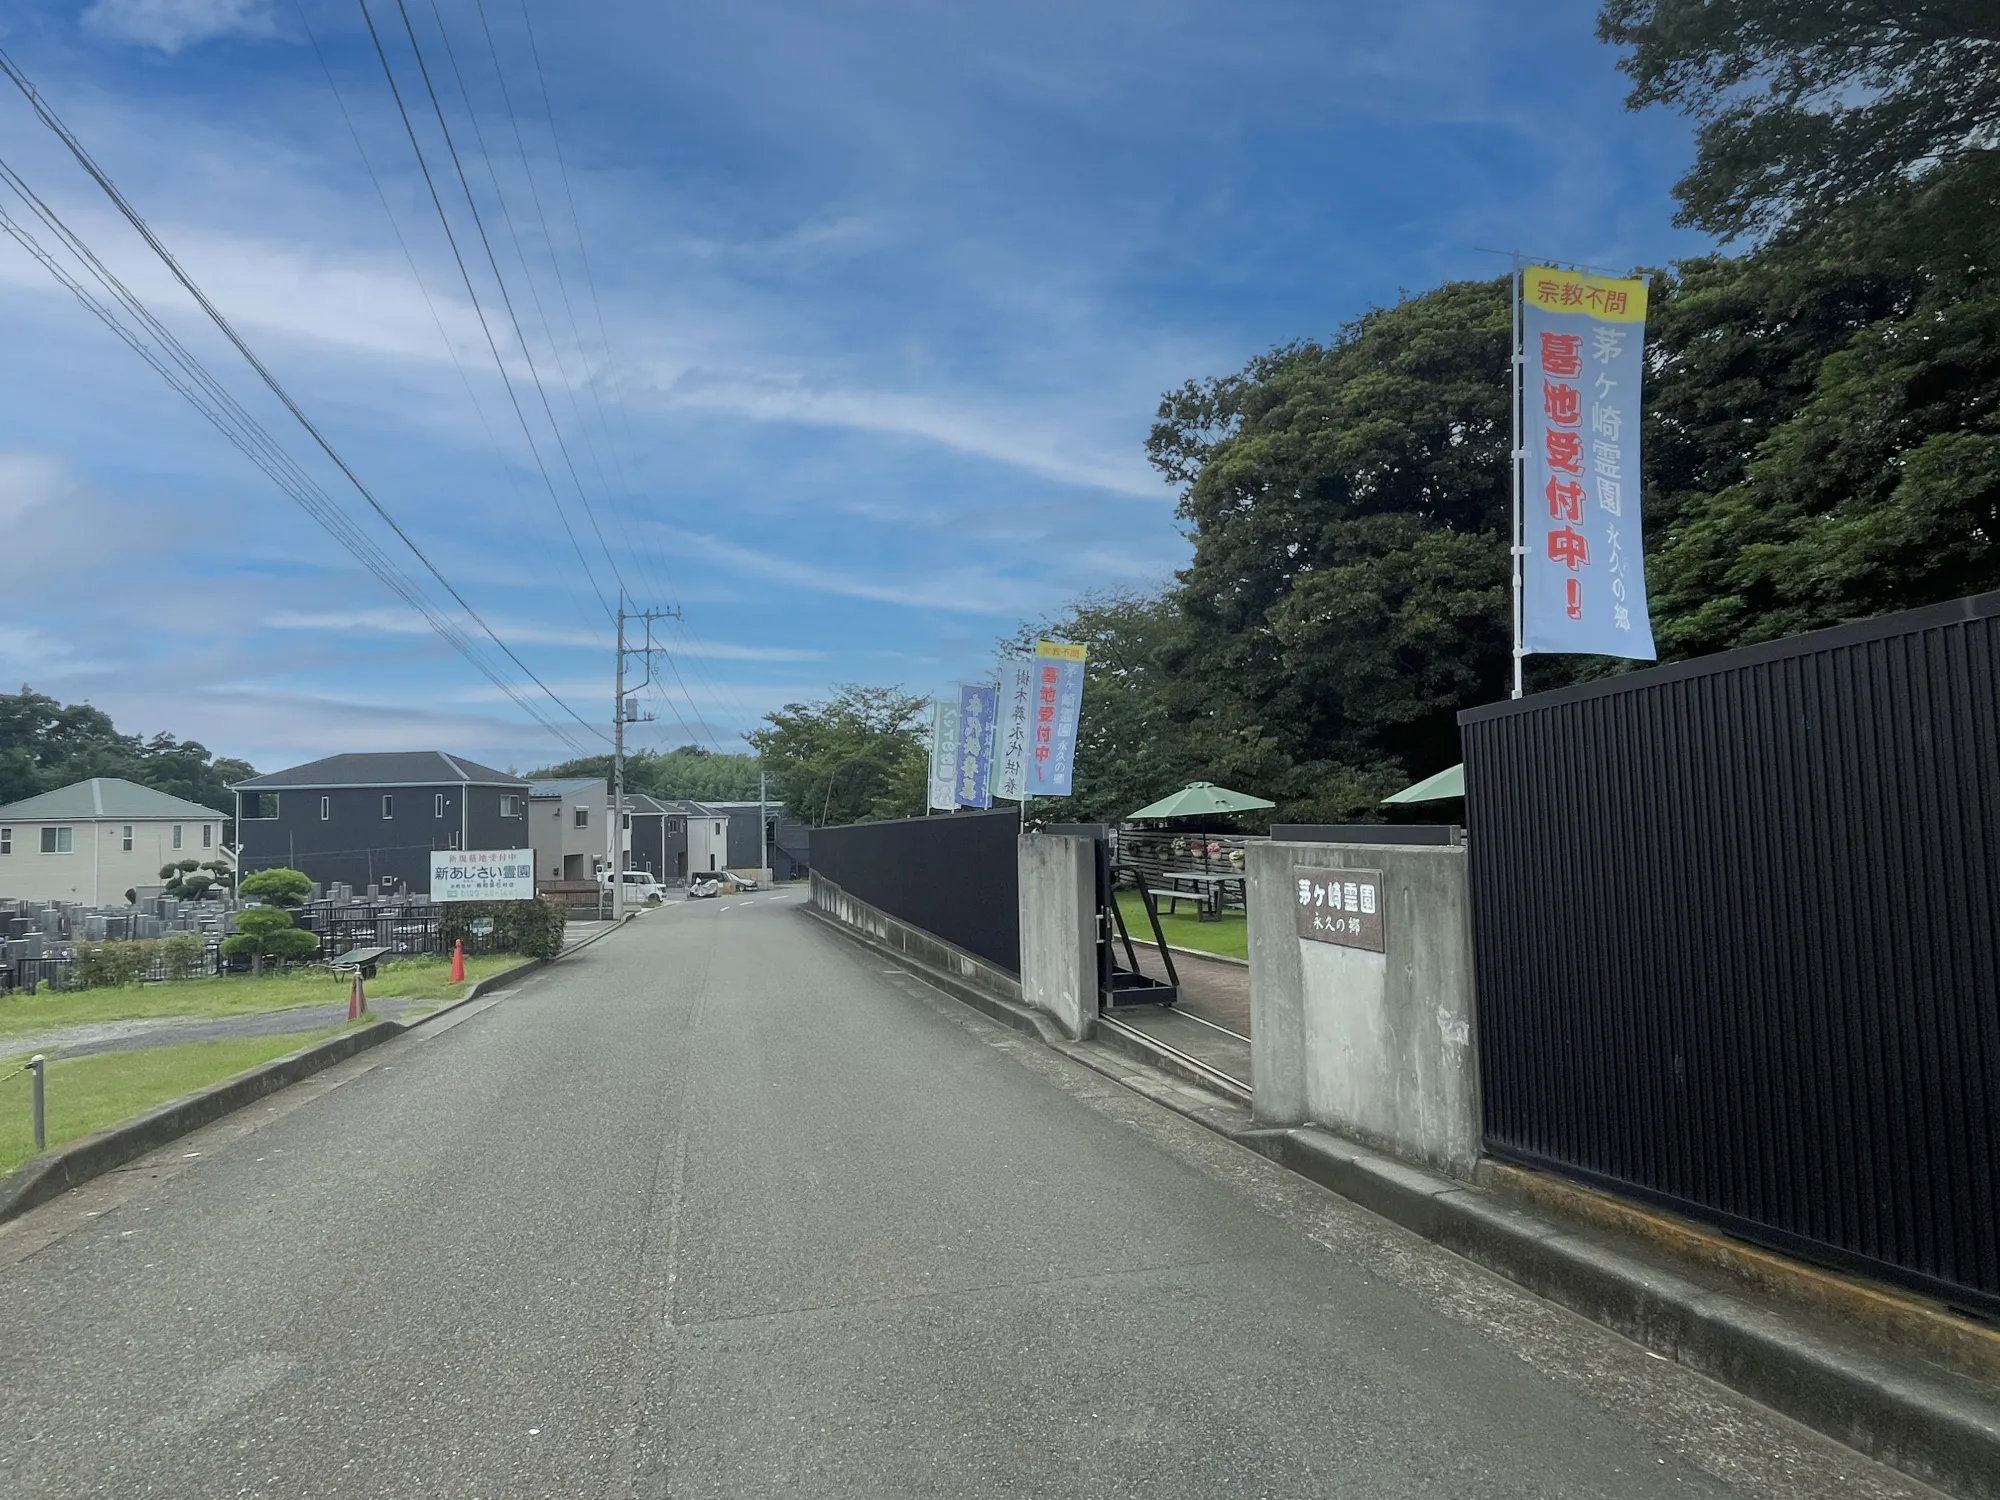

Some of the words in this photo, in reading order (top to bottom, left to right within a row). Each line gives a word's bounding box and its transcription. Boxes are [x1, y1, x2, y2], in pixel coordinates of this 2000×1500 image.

[1537, 280, 1628, 315] 宗教不問
[435, 865, 531, 881] 新あじさい霊園
[1313, 912, 1360, 936] 永久の郷
